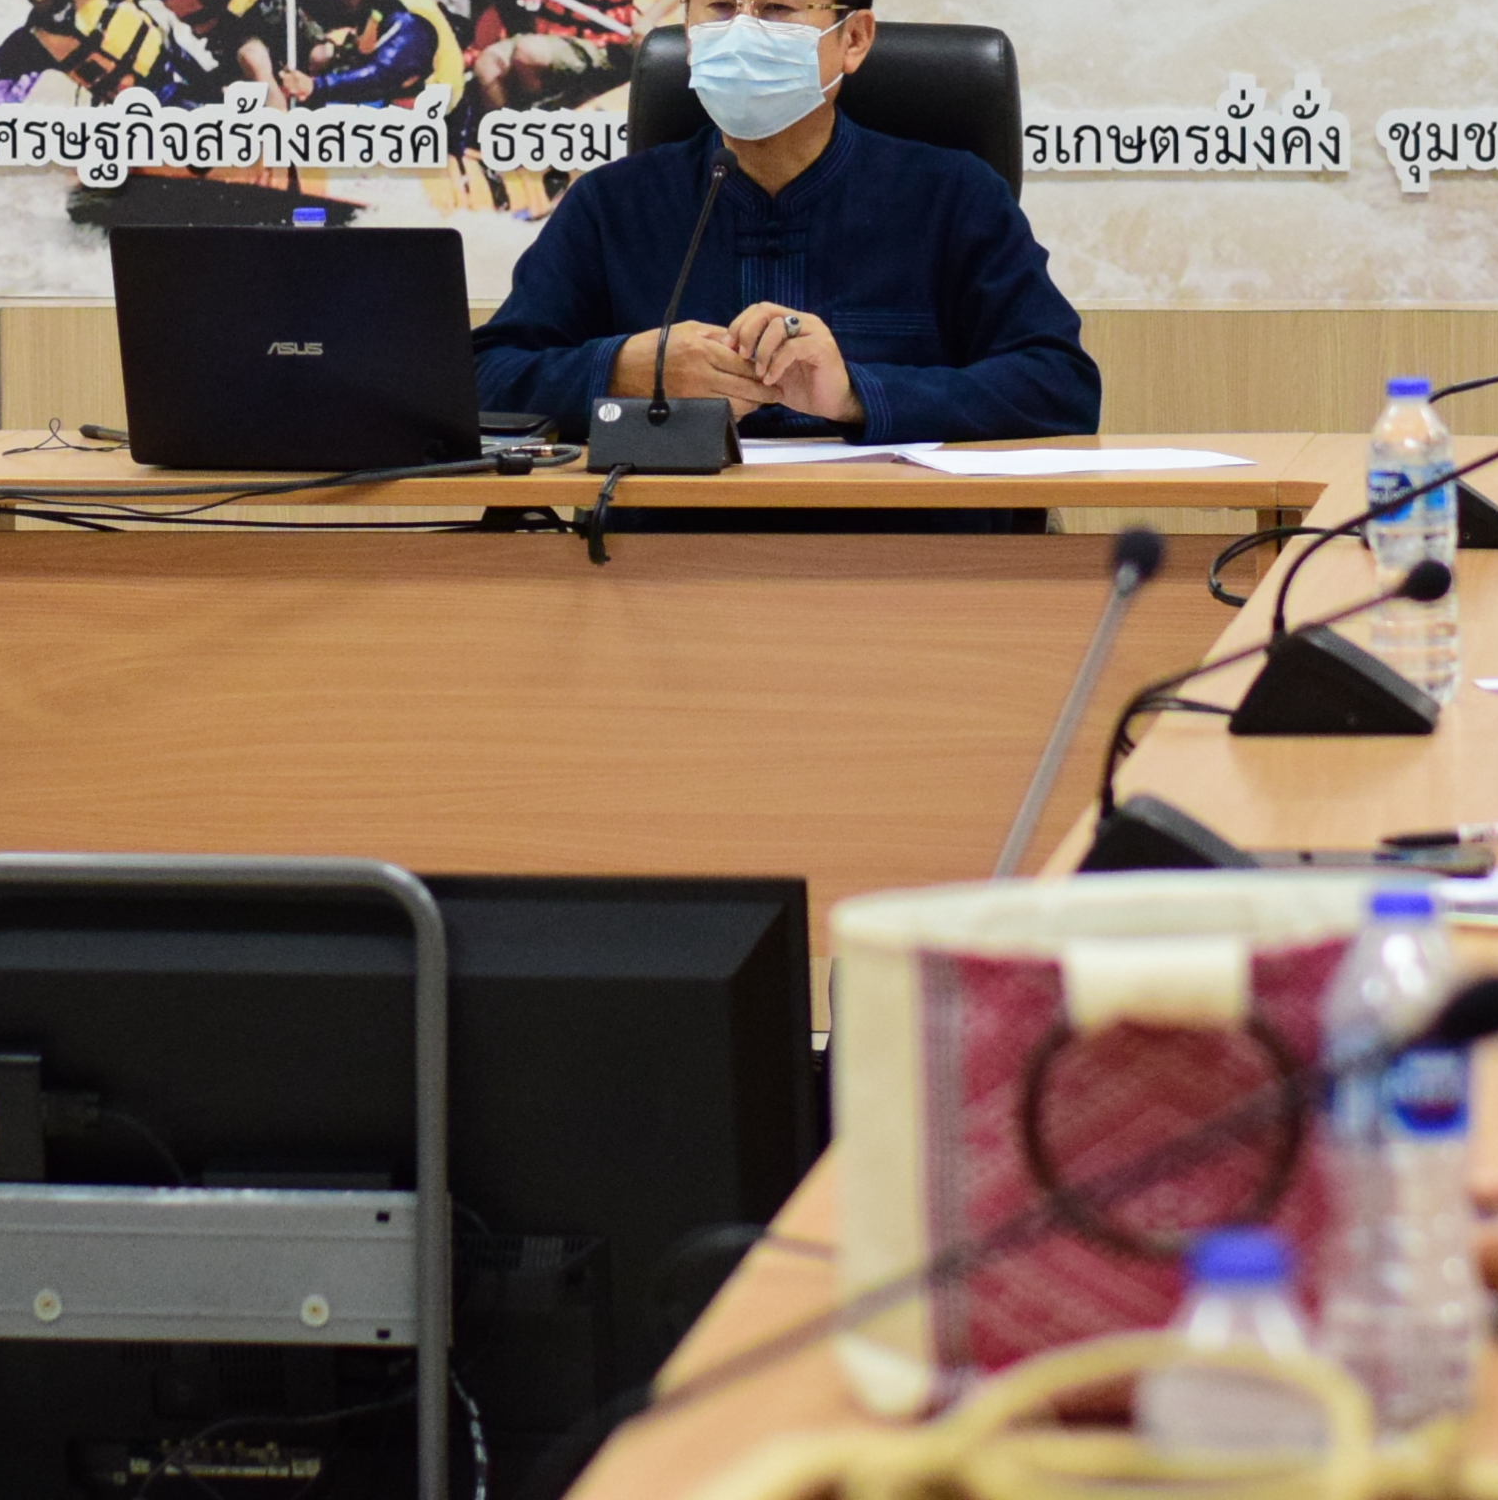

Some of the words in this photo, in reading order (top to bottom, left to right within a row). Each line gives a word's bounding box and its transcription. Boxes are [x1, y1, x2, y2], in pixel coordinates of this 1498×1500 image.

[490, 122, 628, 163] ธรรม
[1024, 88, 1341, 165] รเกษตรมั่งคั่ง
[266, 341, 324, 356] ASUS
